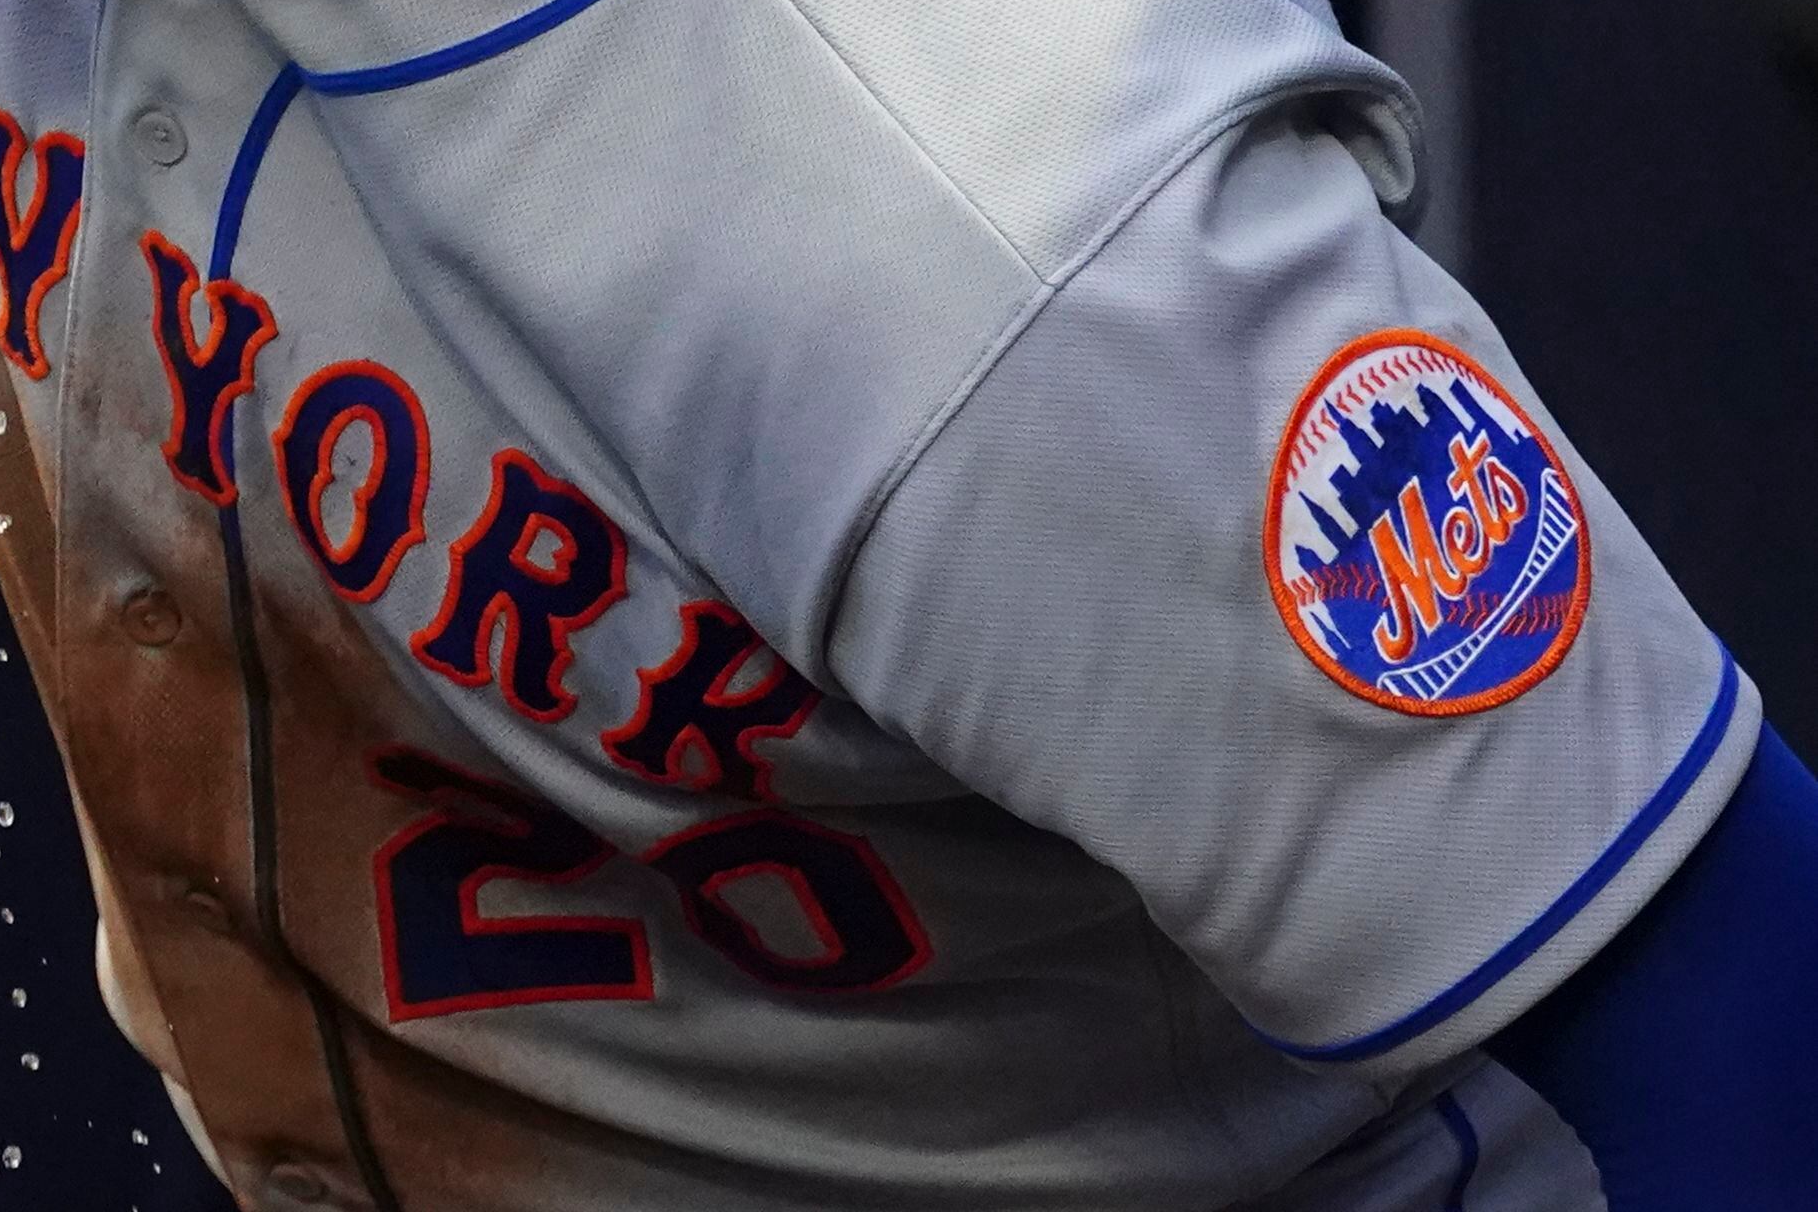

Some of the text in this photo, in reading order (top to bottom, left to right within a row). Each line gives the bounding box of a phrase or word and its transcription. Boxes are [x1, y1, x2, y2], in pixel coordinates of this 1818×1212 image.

[139, 229, 824, 802] YORK
[1369, 429, 1529, 664] Mets
[368, 741, 936, 1025] 20
